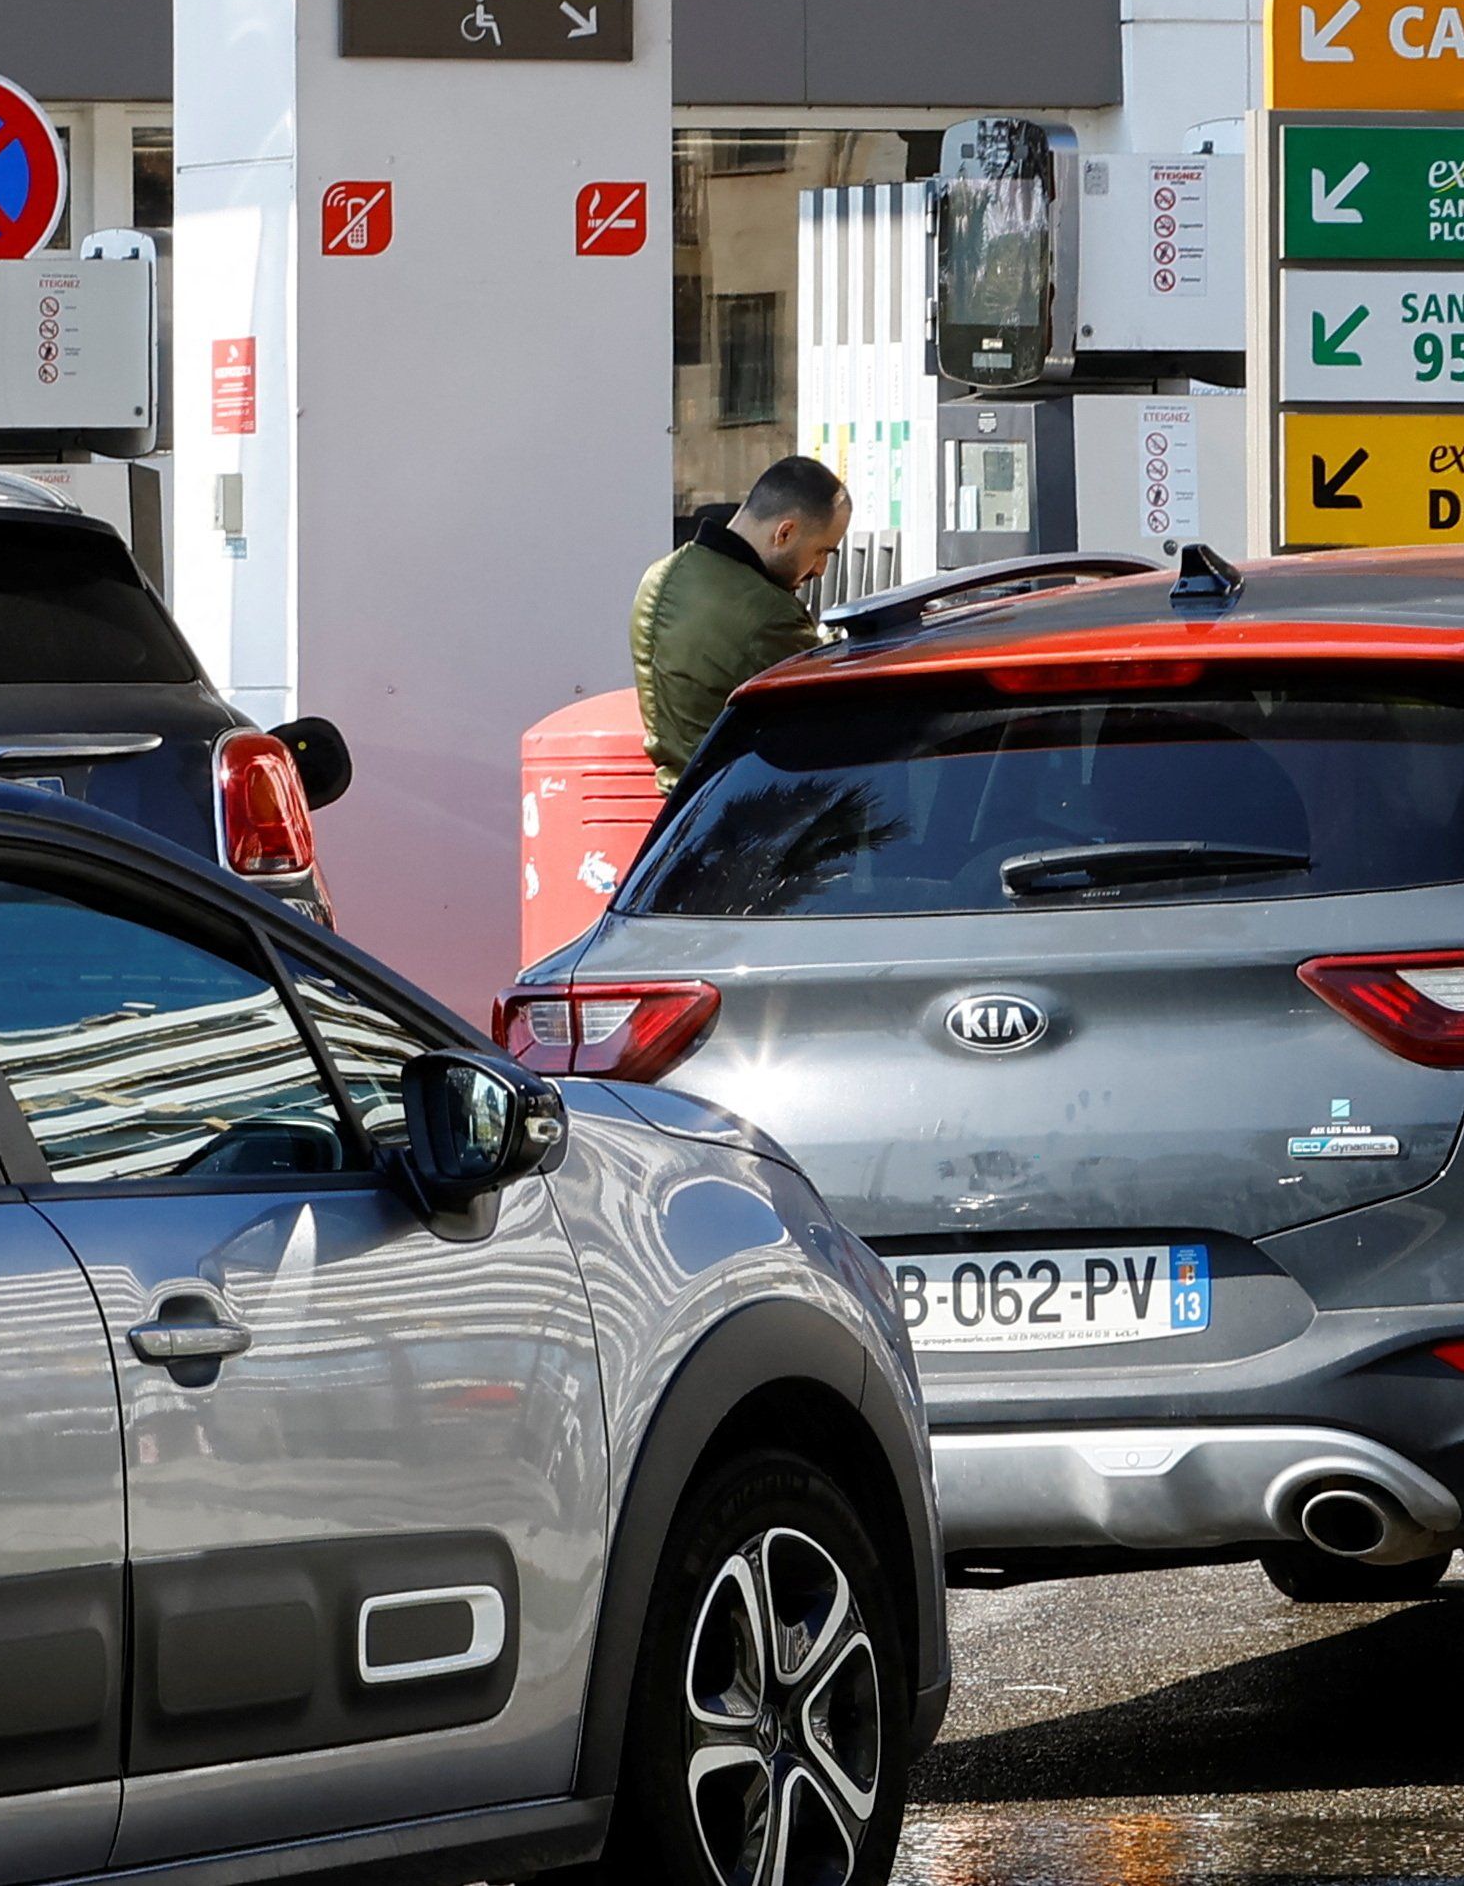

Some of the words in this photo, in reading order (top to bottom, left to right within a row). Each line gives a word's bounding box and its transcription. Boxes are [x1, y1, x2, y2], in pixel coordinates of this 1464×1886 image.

[962, 1002, 1029, 1037] KIA
[1327, 1126, 1341, 1134] LES
[1175, 1291, 1201, 1321] 13
